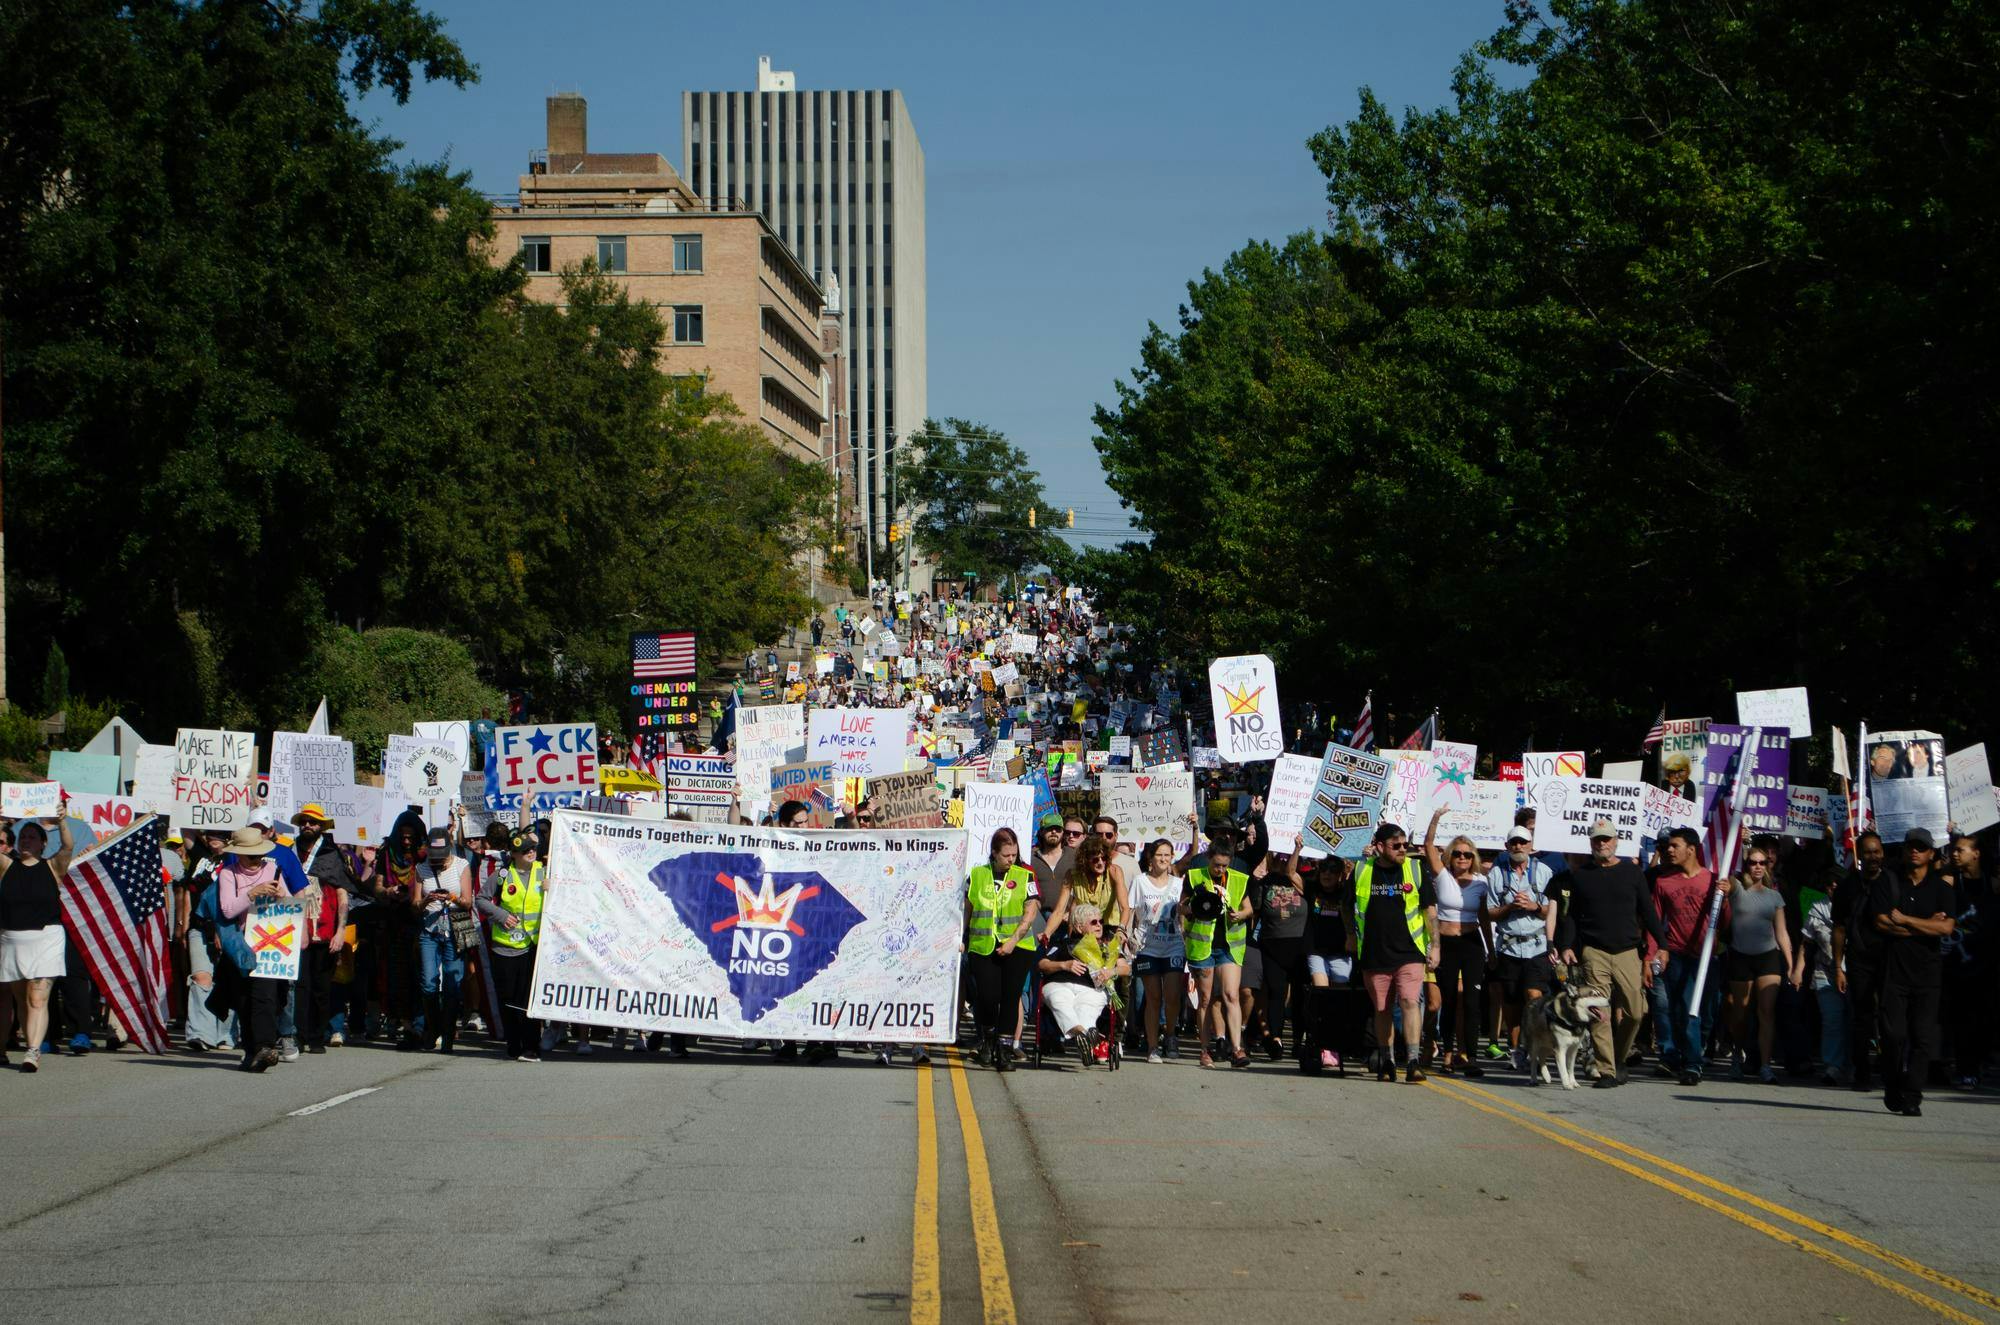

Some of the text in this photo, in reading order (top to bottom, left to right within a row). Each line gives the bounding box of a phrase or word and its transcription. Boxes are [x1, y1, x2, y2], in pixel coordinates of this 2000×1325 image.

[630, 681, 696, 696] ONE NATION
[644, 696, 688, 708] UNDER
[639, 712, 698, 727] DISTRESS
[840, 713, 876, 733] LOVE
[1229, 714, 1264, 736] NO
[1664, 718, 1713, 736] PUBLIC
[178, 731, 249, 760] WAKE ME
[818, 734, 877, 748] AMERICA
[1231, 731, 1282, 754] KINGS
[1664, 734, 1710, 752] ENEMY
[1762, 734, 1788, 750] LET
[293, 744, 348, 756] AMERICA:
[404, 746, 458, 769] RAVERS AGAINST
[840, 750, 868, 760] HATE
[179, 758, 237, 779] UP WHEN
[294, 757, 346, 772] BUILT BY
[669, 758, 692, 772] NO
[1283, 758, 1306, 772] Then
[1334, 752, 1384, 775] NO KING
[1502, 765, 1524, 776] What
[1526, 756, 1554, 778] NO
[604, 768, 629, 779] NO
[771, 765, 832, 789] UNITED WE
[1276, 771, 1298, 783] came
[175, 777, 250, 806] FASCISM
[418, 786, 444, 796] FACISM
[668, 778, 732, 790] NO DICTATORS
[868, 781, 882, 796] IF
[883, 777, 905, 791] YOU
[906, 772, 934, 788] DONT
[1112, 776, 1189, 792] I AMERICA
[1326, 770, 1378, 796] NO POPE
[1580, 783, 1640, 798] SCREWING
[311, 787, 336, 801] NOT
[684, 794, 727, 802] OLIGARCHS
[783, 782, 820, 802] STAND
[886, 786, 924, 804] WANT
[1792, 787, 1820, 806] Long
[874, 794, 940, 822] CRIMINALS
[966, 785, 1032, 820] Democracy
[1111, 795, 1174, 812] Thats why
[1582, 798, 1636, 812] AMERICA
[92, 799, 133, 827] NO
[192, 805, 233, 825] ENDS
[1141, 811, 1170, 824] here!
[1270, 812, 1292, 822] NOT
[1334, 813, 1368, 828] LYING
[1563, 810, 1590, 822] LIKE
[1618, 814, 1638, 826] HIS
[974, 813, 1022, 832] Needs
[572, 820, 949, 854] SC Stands Together: No Thrones. No Crowns. No Kings.
[1312, 817, 1342, 846] DOPE
[257, 903, 303, 920] KINGS
[731, 929, 792, 961] NO
[260, 950, 282, 962] NO
[256, 962, 295, 978] ELONS
[729, 958, 790, 977] KINGS
[542, 982, 719, 1020] SOUTH CAROLINA
[812, 1000, 934, 1031] 10/18/2025
